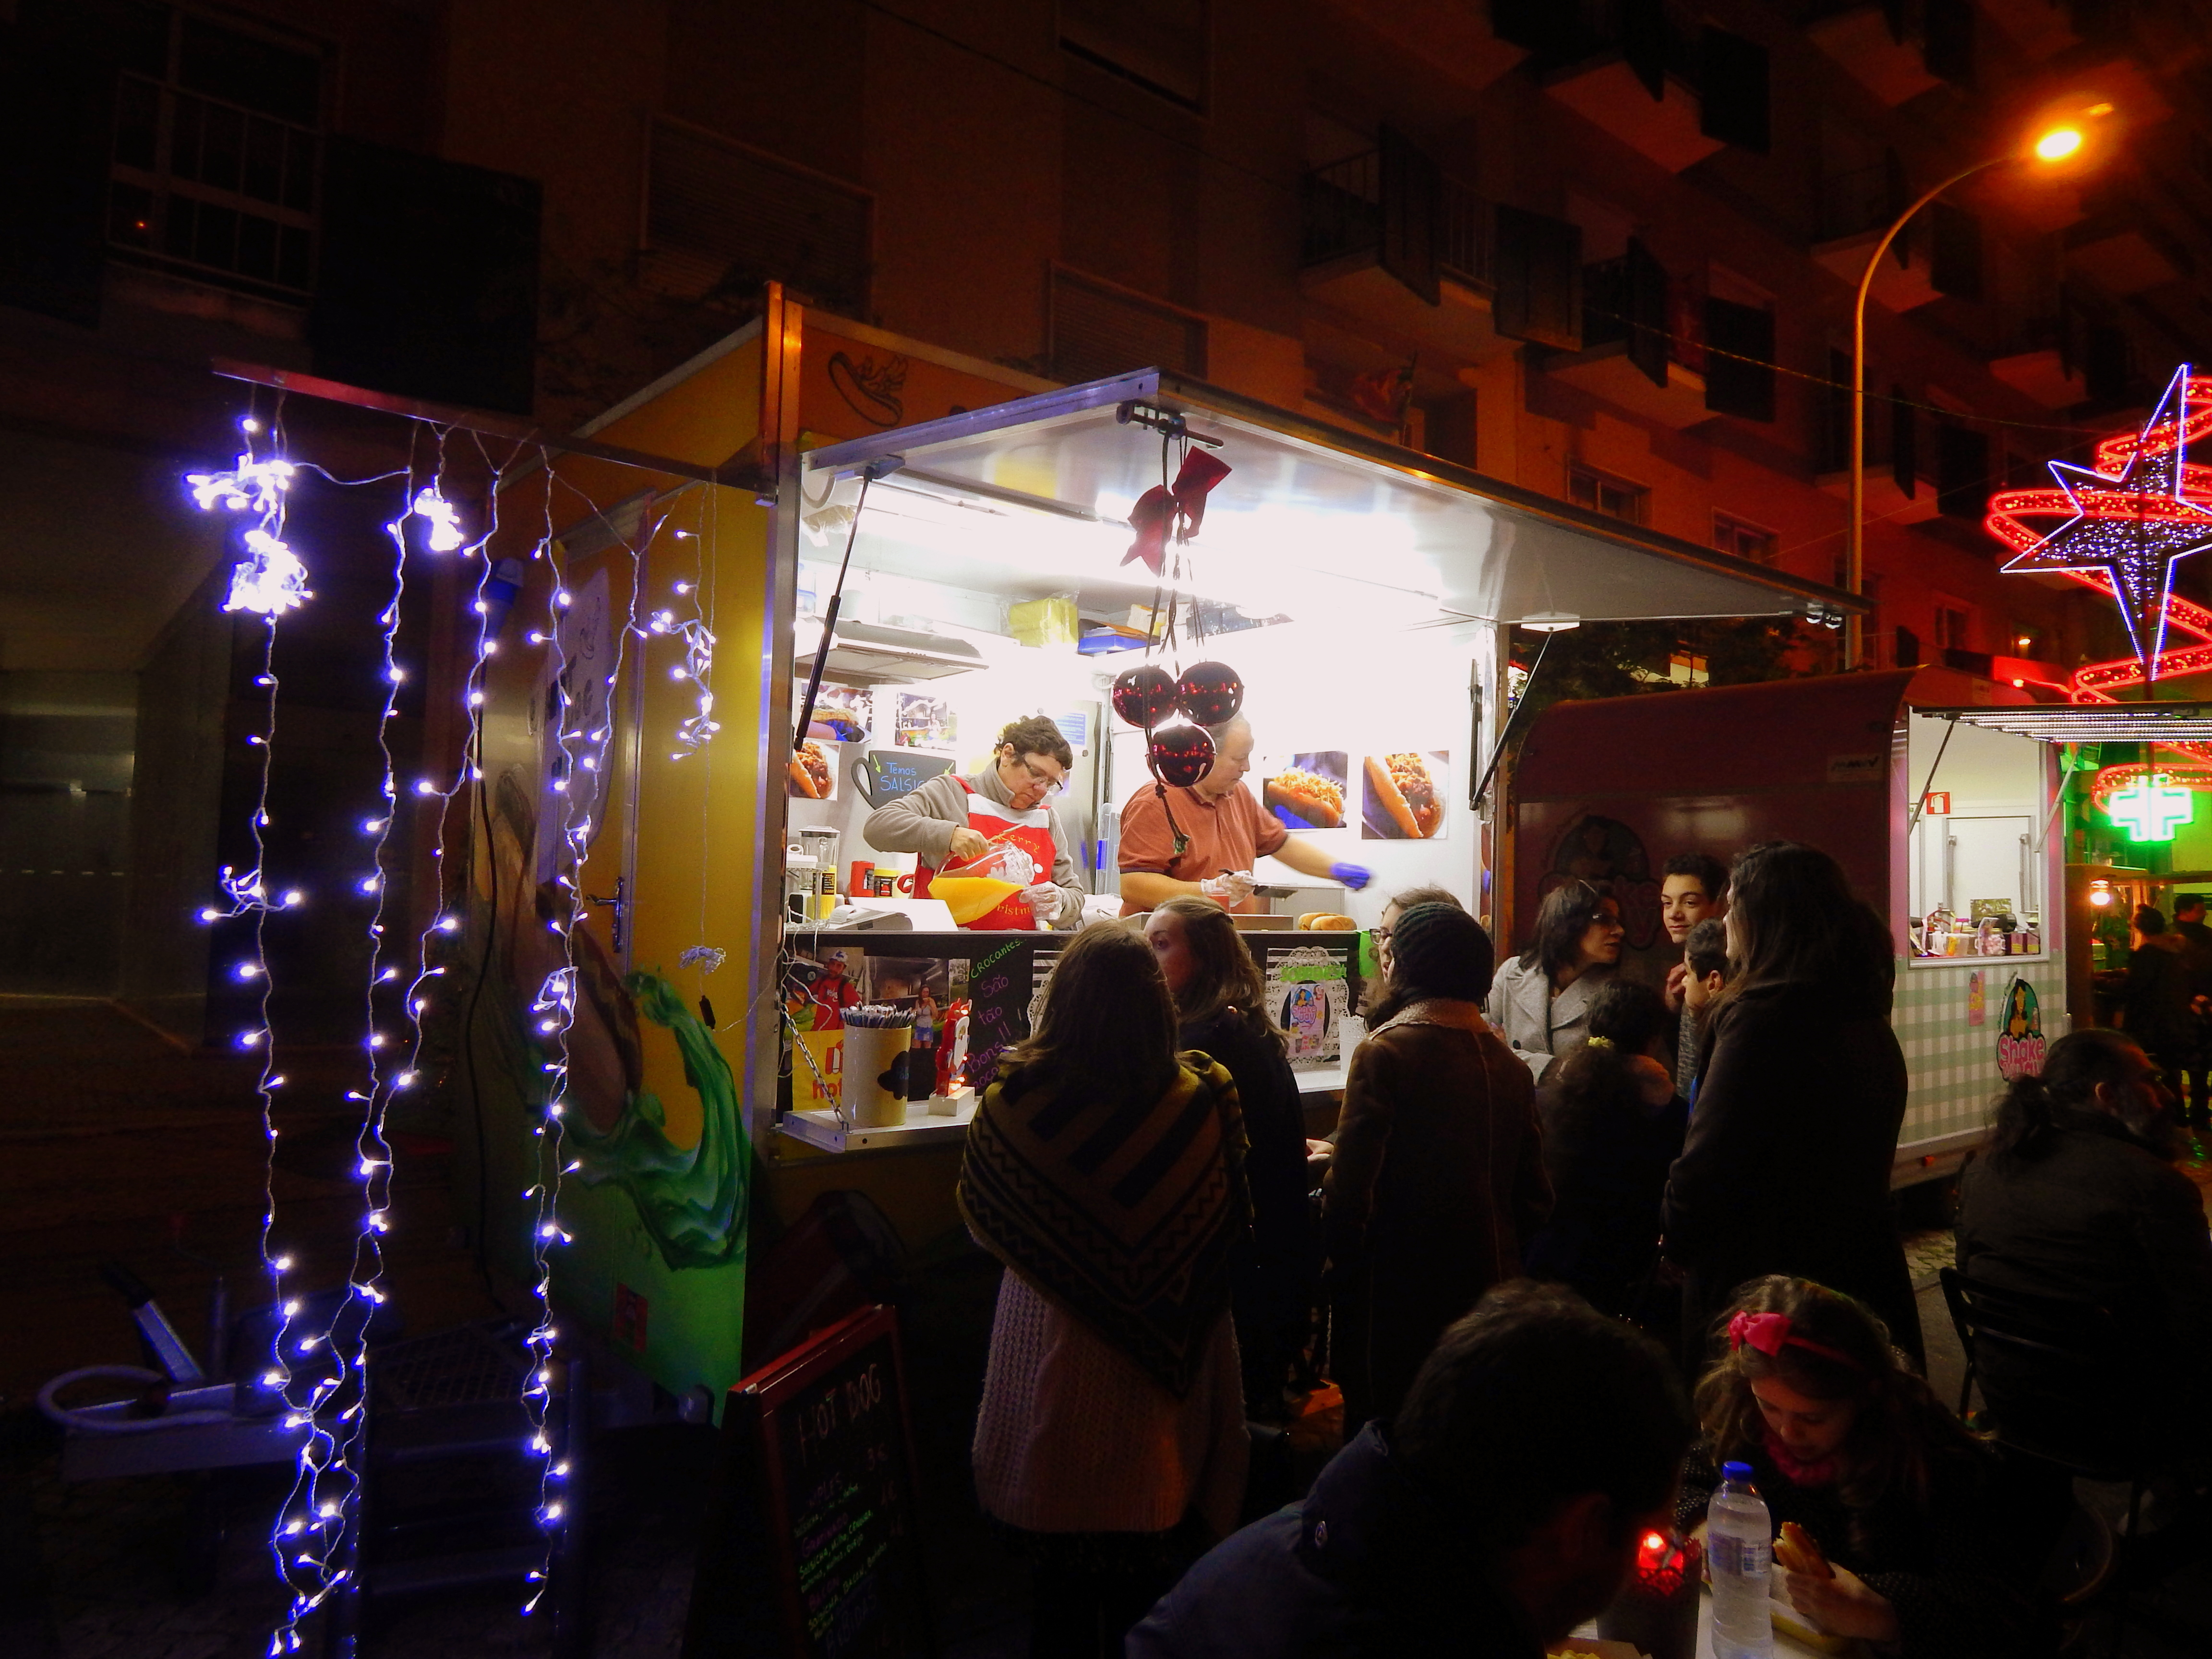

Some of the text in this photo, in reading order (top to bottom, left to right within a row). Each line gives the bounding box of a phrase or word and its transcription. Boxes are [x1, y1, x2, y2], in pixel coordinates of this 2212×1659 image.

[886, 762, 917, 776] Temos
[981, 974, 1009, 998] São
[977, 1006, 1002, 1025] tão
[1999, 1033, 2045, 1063] Shake
[799, 1363, 881, 1468] HOT DOG
